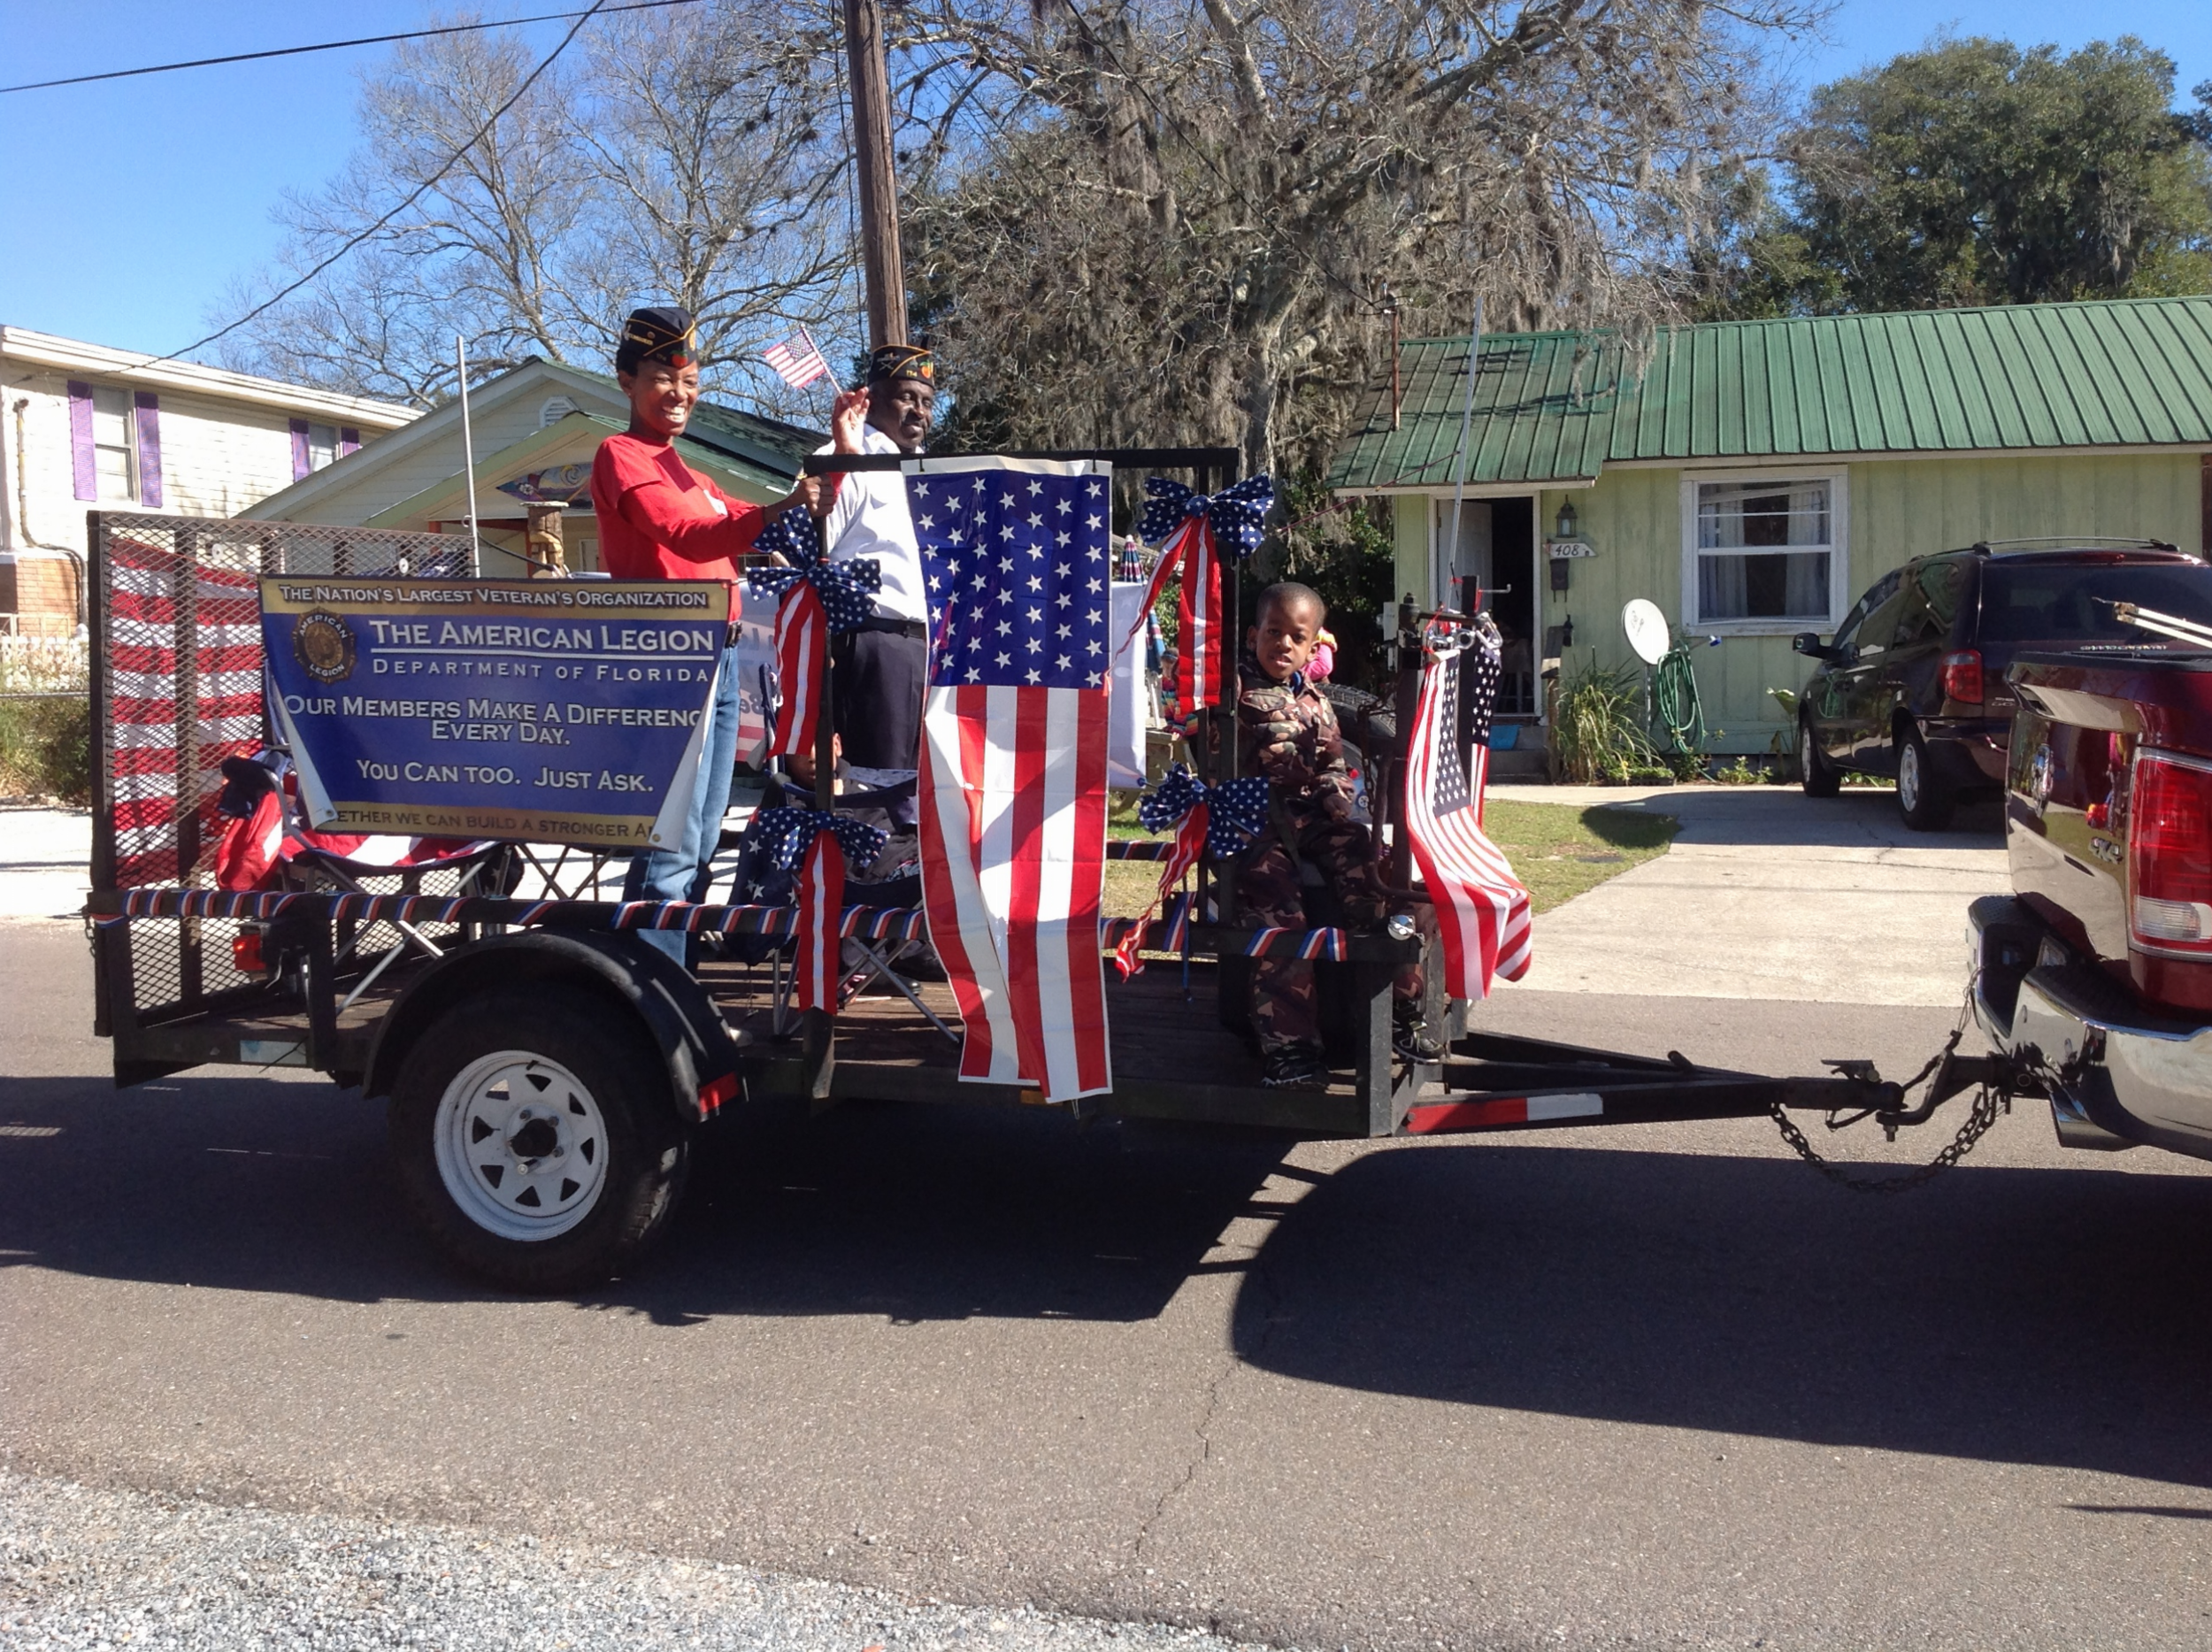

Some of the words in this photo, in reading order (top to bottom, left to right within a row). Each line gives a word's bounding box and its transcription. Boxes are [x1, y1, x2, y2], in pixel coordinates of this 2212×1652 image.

[1555, 544, 1580, 557] 408
[280, 585, 312, 601] THE
[315, 586, 394, 602] NATION'S
[397, 588, 473, 603] LARGEST
[476, 588, 573, 604] VETERAN'S
[576, 590, 707, 606] ORGANIZATION
[299, 614, 348, 639] AMERICAN
[369, 620, 431, 644] THE
[439, 621, 594, 649] AMERICAN
[601, 626, 714, 651] LEGION
[309, 664, 345, 677] LEGION
[373, 658, 542, 678] DEPARTMENT
[555, 666, 584, 680] OF
[596, 665, 709, 682] FLORIDA
[283, 695, 336, 715] OUR
[342, 696, 461, 718] MEMBERS
[467, 699, 537, 721] MAKE
[543, 703, 562, 723] A
[432, 719, 513, 741] EVERY
[519, 722, 571, 746] DAY.
[356, 759, 399, 780] YOU
[404, 762, 459, 782] CAN
[464, 766, 521, 785] TOO.
[534, 767, 592, 788] JUST
[597, 770, 655, 792] ASK.
[337, 810, 391, 824] ETHER
[395, 812, 422, 825] WE
[422, 814, 461, 827] CAN
[467, 816, 517, 829] BUILD
[522, 818, 533, 831] A
[539, 819, 629, 837] STRONGER
[634, 823, 652, 838] A
